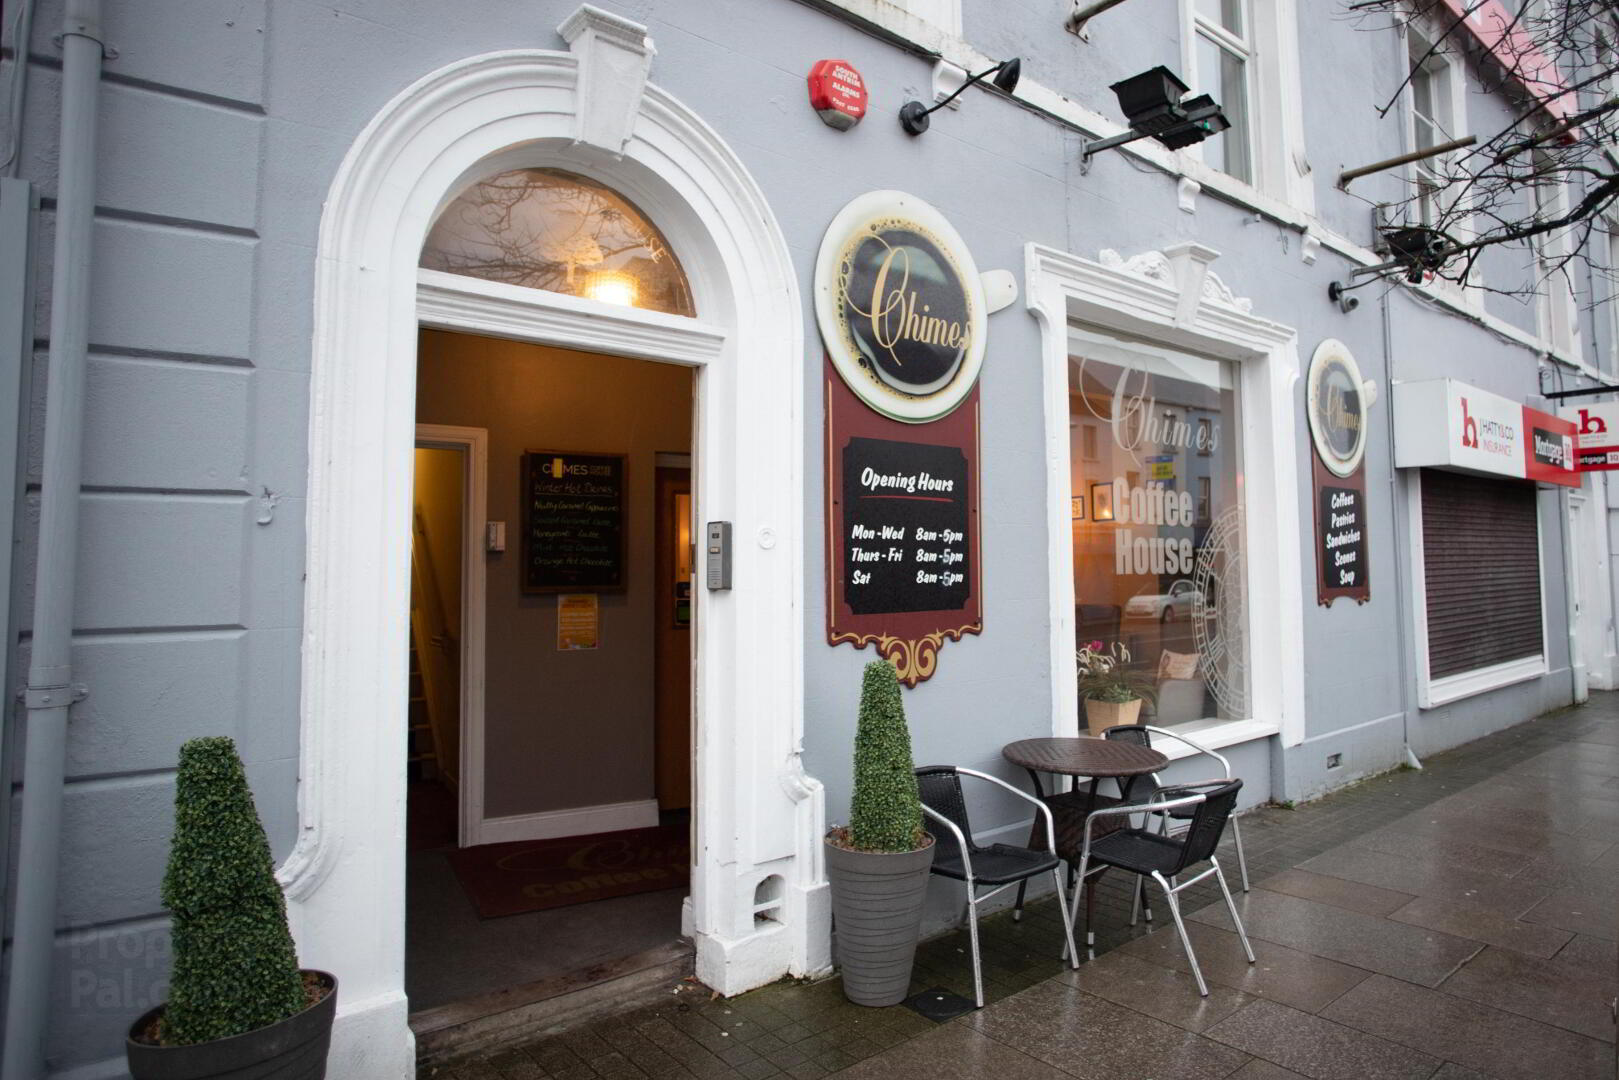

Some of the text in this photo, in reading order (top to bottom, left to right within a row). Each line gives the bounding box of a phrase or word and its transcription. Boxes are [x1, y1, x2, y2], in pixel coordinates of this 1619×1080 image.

[840, 234, 972, 366] Chimes
[1079, 354, 1220, 467] Chimes
[861, 467, 954, 493] Opening Hours
[1113, 476, 1194, 526] Coffee
[1331, 512, 1355, 528] Pastries
[1115, 528, 1195, 575] House
[1326, 529, 1361, 549] Sandwiches
[852, 570, 871, 584] Sat
[1340, 569, 1355, 585] Soup
